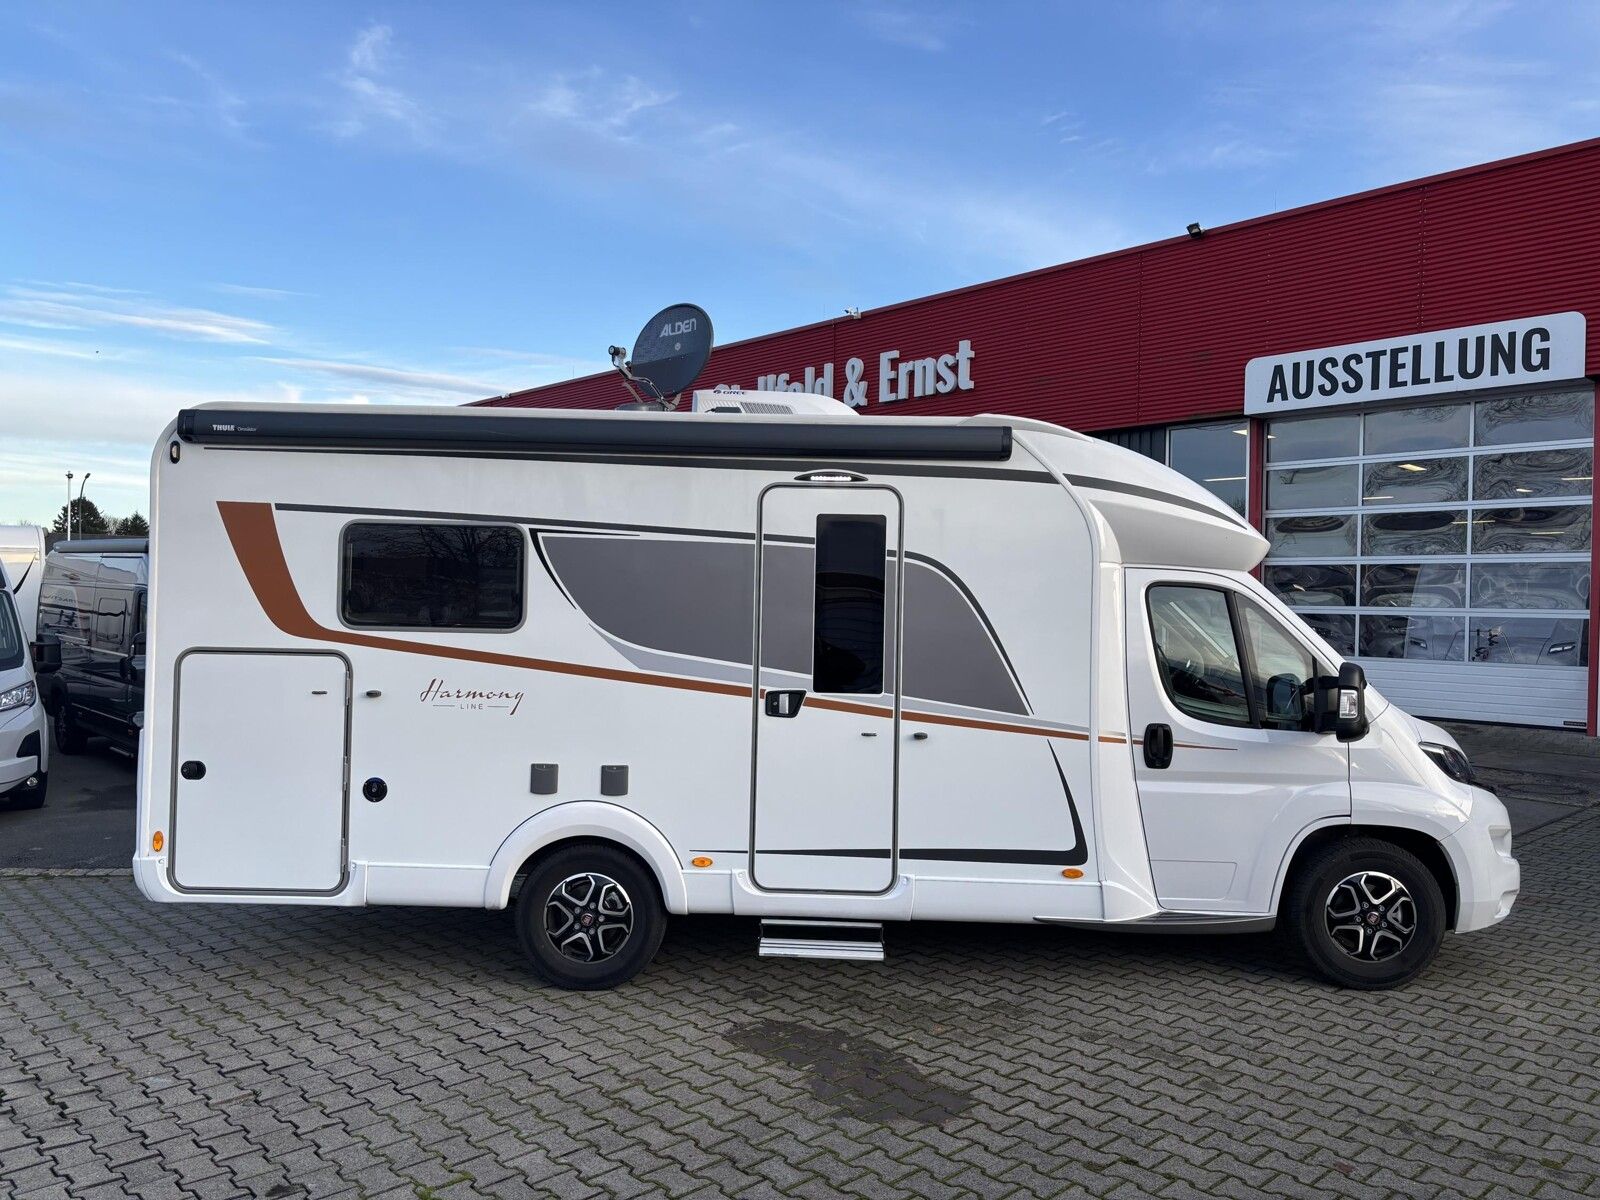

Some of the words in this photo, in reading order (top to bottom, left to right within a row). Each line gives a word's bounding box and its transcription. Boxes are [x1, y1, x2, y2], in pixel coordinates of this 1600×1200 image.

[659, 318, 697, 338] ALDEN
[844, 357, 868, 408] &
[878, 339, 976, 403] Ernst
[1266, 327, 1550, 403] AUSSTELLUNG
[212, 424, 235, 432] THULE
[419, 678, 525, 716] Harmony
